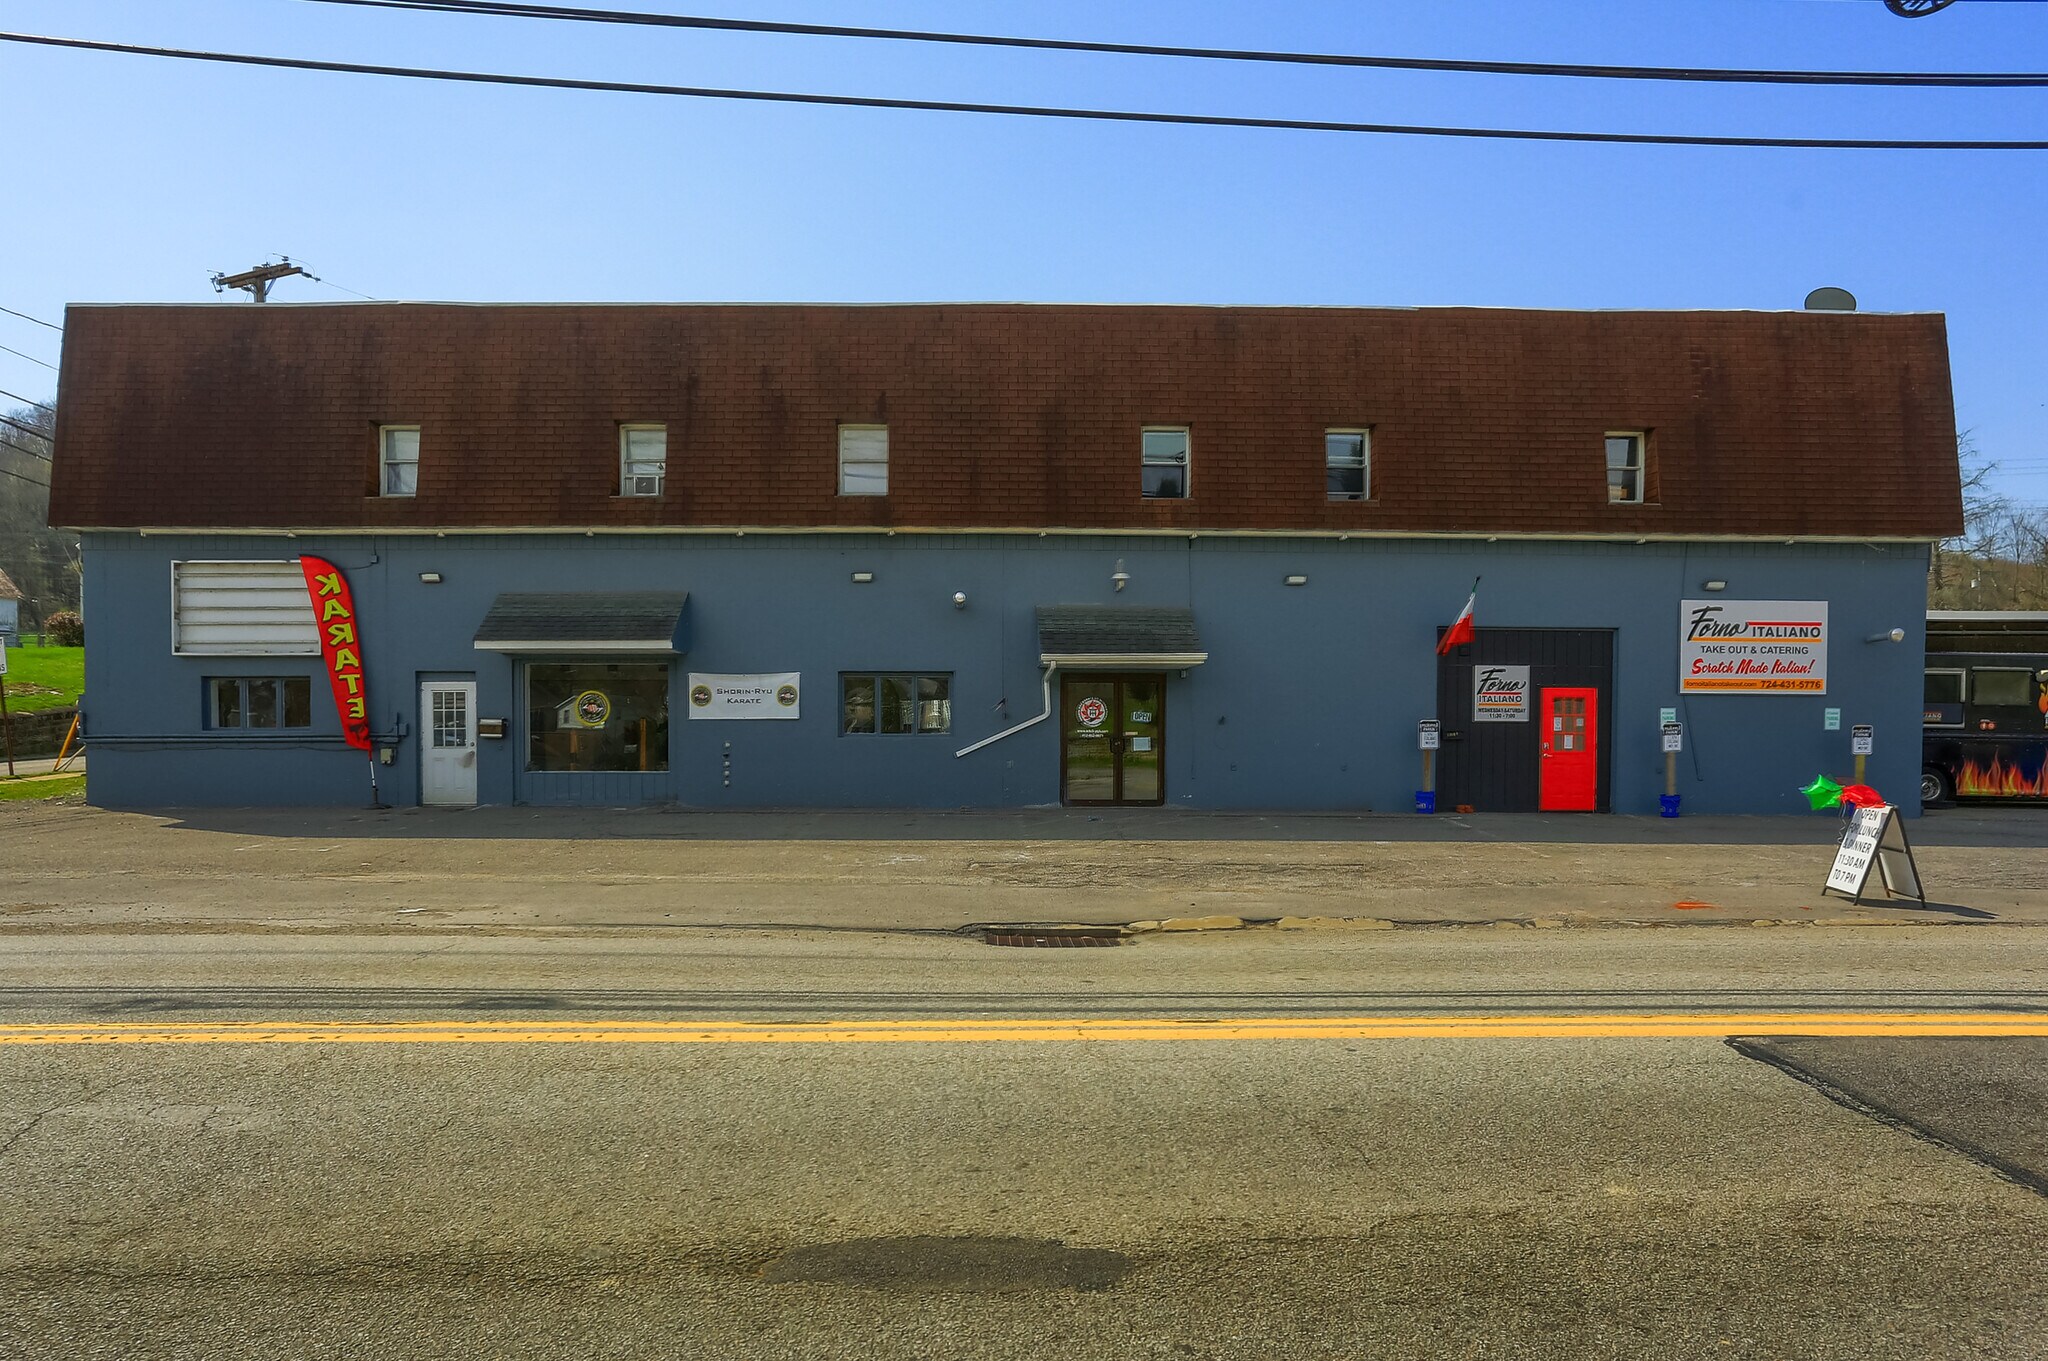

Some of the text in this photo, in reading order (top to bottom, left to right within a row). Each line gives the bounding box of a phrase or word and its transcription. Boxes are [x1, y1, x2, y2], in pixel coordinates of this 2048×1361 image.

[1687, 605, 1821, 641] Forno ITALIANO
[1701, 645, 1809, 655] TAKE OUT & CATERING
[1691, 658, 1816, 675] Scratch Made Italian!
[1477, 668, 1527, 695] Forno
[1761, 680, 1821, 689] 724-431-5776
[1133, 712, 1151, 721] OPEN
[1861, 809, 1879, 821] OPEN
[1848, 822, 1881, 839] FOR LUNCH
[1838, 853, 1866, 869] 11:30 AM
[1833, 868, 1857, 884] TO 7 PM
